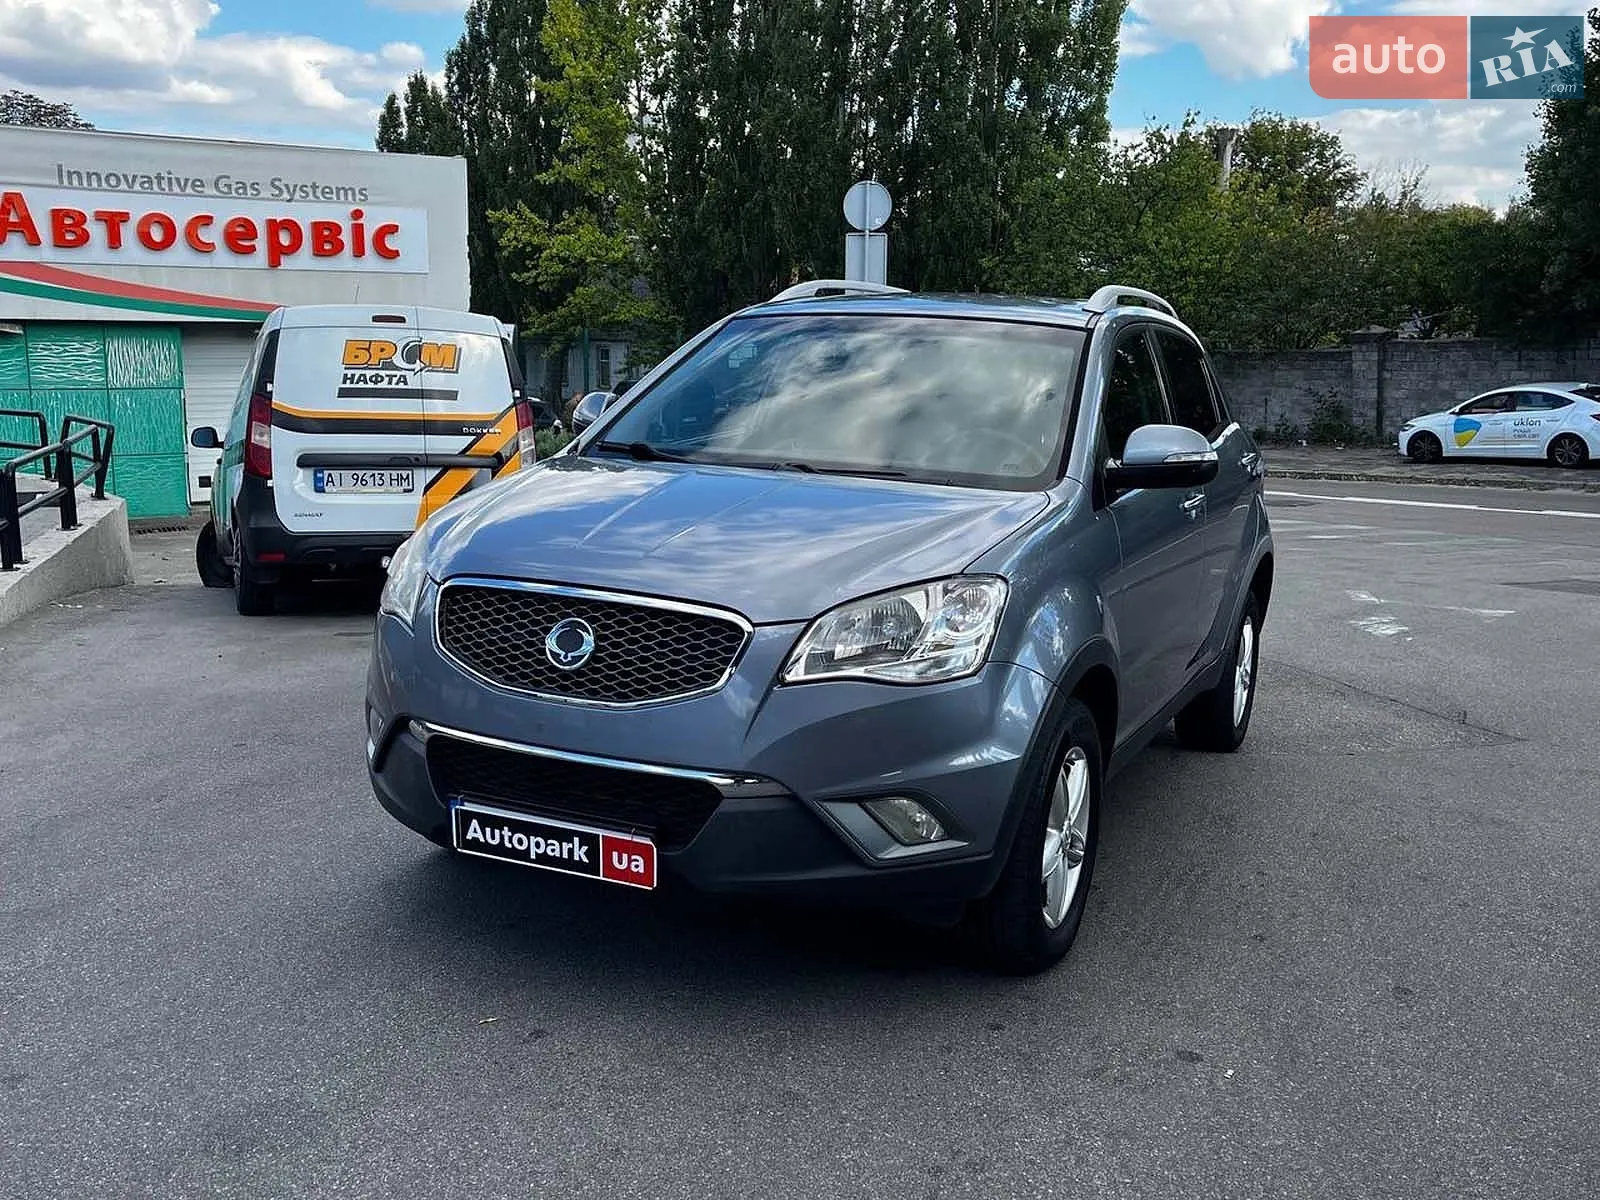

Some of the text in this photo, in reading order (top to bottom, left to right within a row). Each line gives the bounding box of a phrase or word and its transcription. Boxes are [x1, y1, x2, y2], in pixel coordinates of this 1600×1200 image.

[56, 163, 369, 203] Innovative Gas Systems
[0, 191, 401, 268] Автосервіс
[342, 372, 409, 386] НАФТА
[351, 472, 385, 487] 9613
